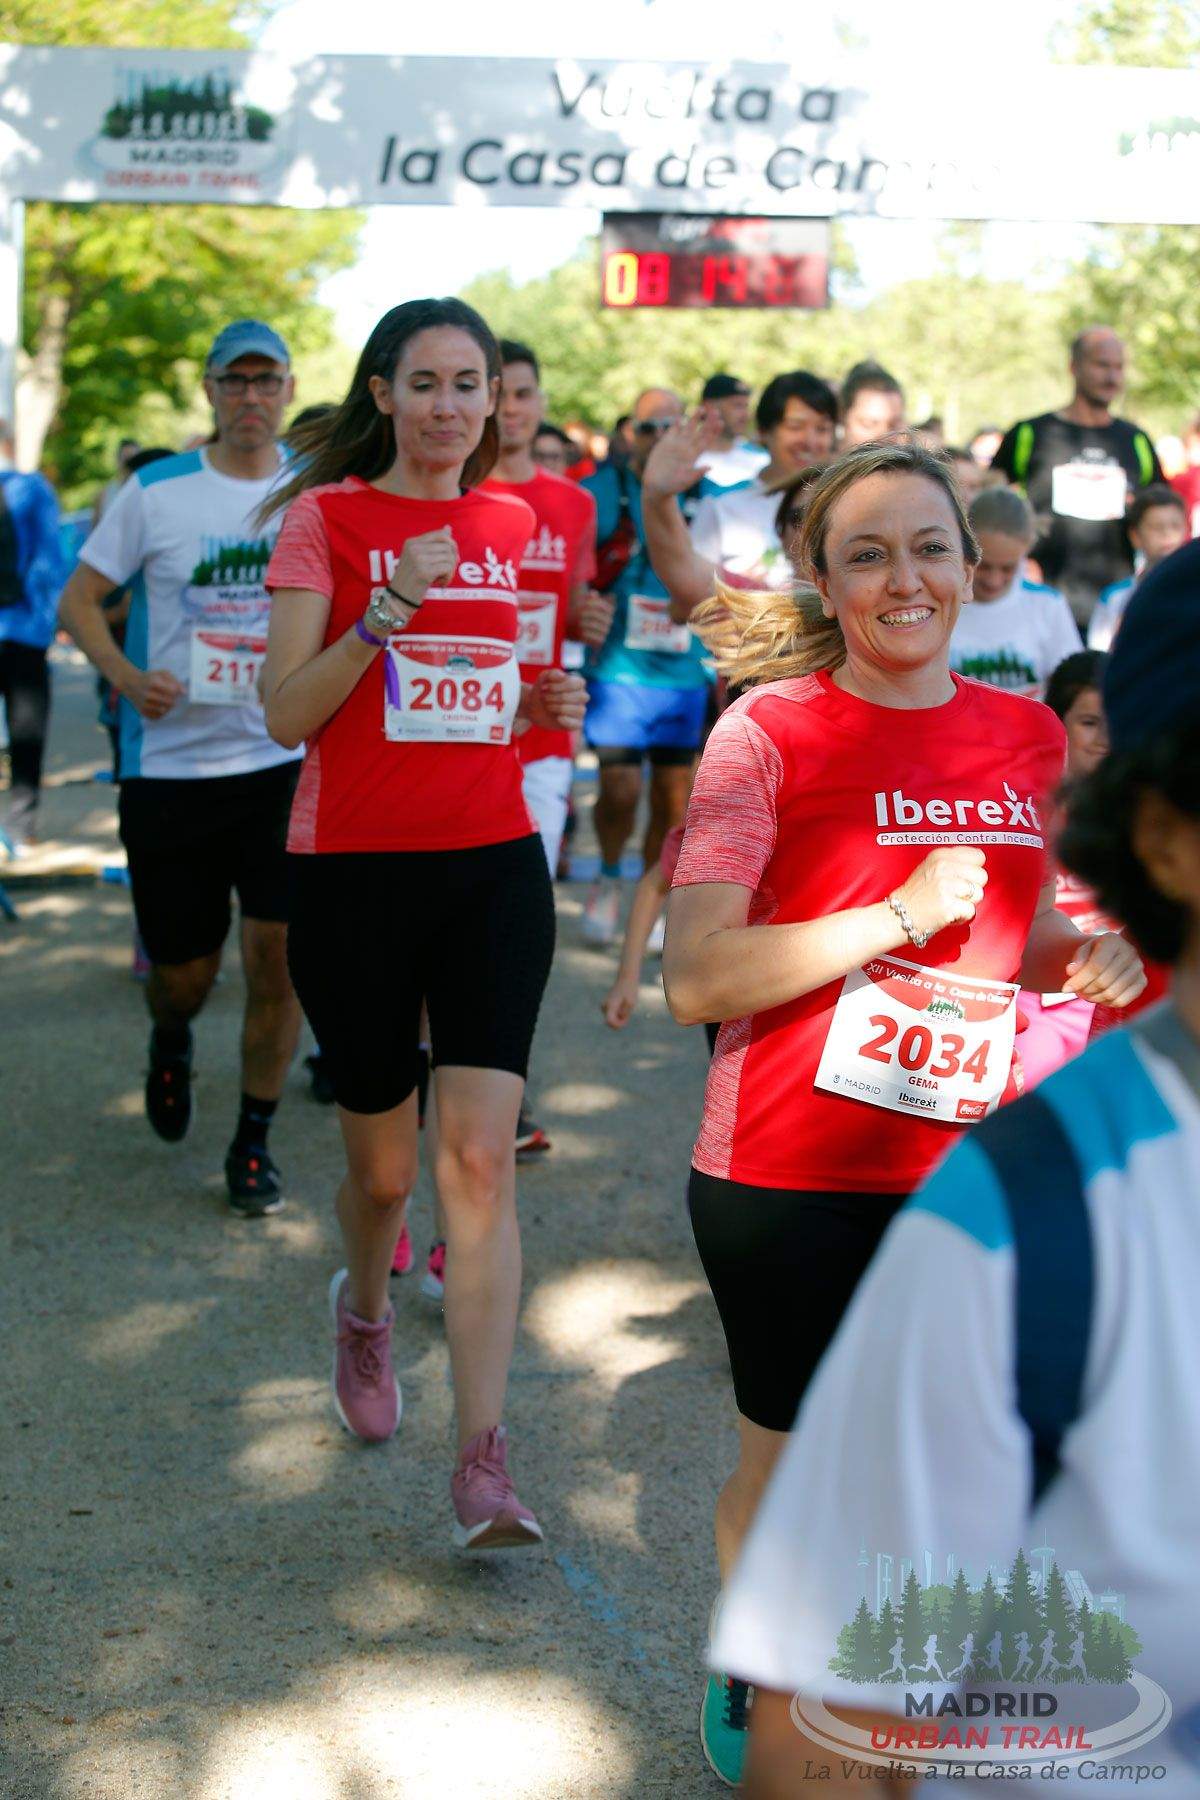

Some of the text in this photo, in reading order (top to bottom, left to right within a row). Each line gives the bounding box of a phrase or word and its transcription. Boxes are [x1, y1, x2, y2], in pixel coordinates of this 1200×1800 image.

[800, 88, 839, 123] a
[379, 135, 438, 186] la
[461, 138, 628, 188] Casa
[656, 143, 736, 189] de
[409, 677, 505, 714] 2084
[874, 781, 1042, 831] Iberext
[881, 833, 950, 844] Protección
[957, 833, 998, 844] Contra
[868, 962, 884, 975] XII
[858, 1014, 992, 1084] 2034
[844, 1078, 882, 1095] MADRID
[898, 1092, 938, 1109] Iberext
[908, 1075, 939, 1091] GEMA
